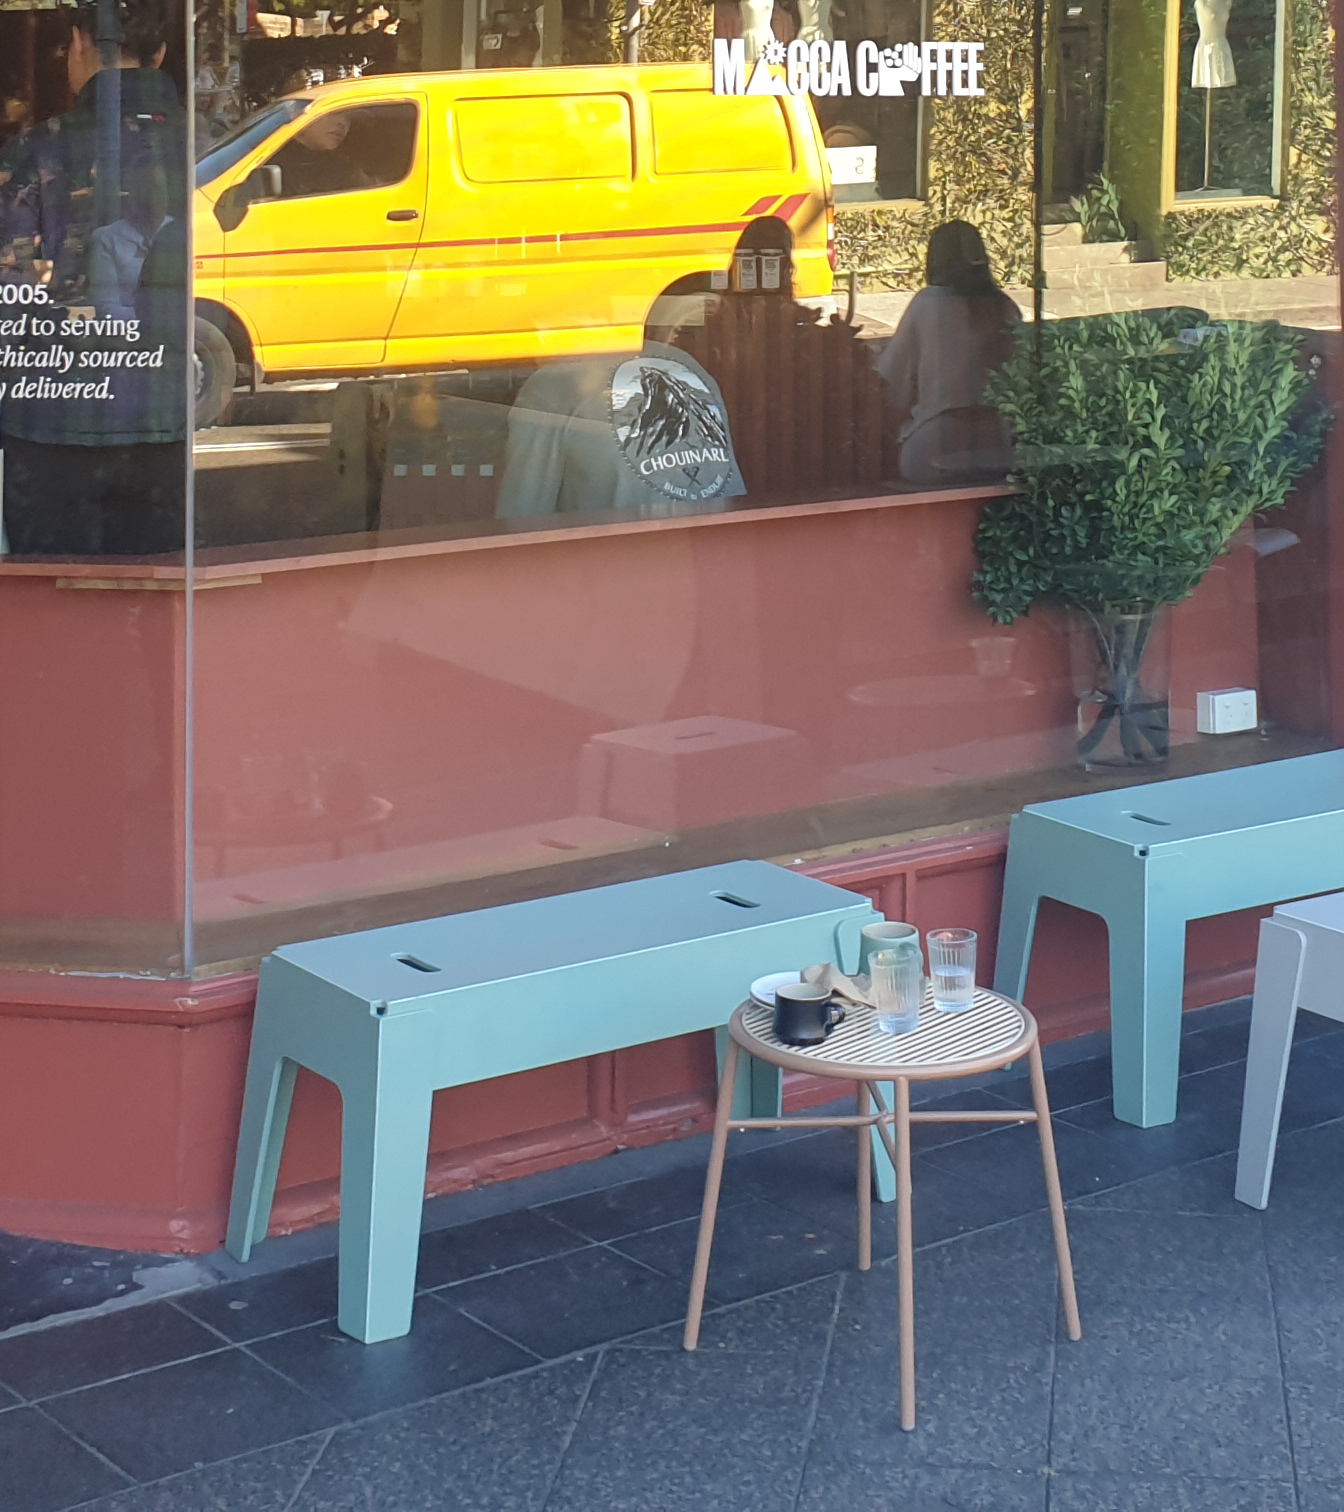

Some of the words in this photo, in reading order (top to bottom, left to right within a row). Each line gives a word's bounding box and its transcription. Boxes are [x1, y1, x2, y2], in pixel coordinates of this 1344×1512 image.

[712, 37, 852, 96] MCCA
[856, 40, 985, 97] CFFEE
[31, 317, 56, 336] to
[60, 314, 141, 341] serving
[78, 345, 165, 368] sourced
[10, 376, 116, 400] delivered.
